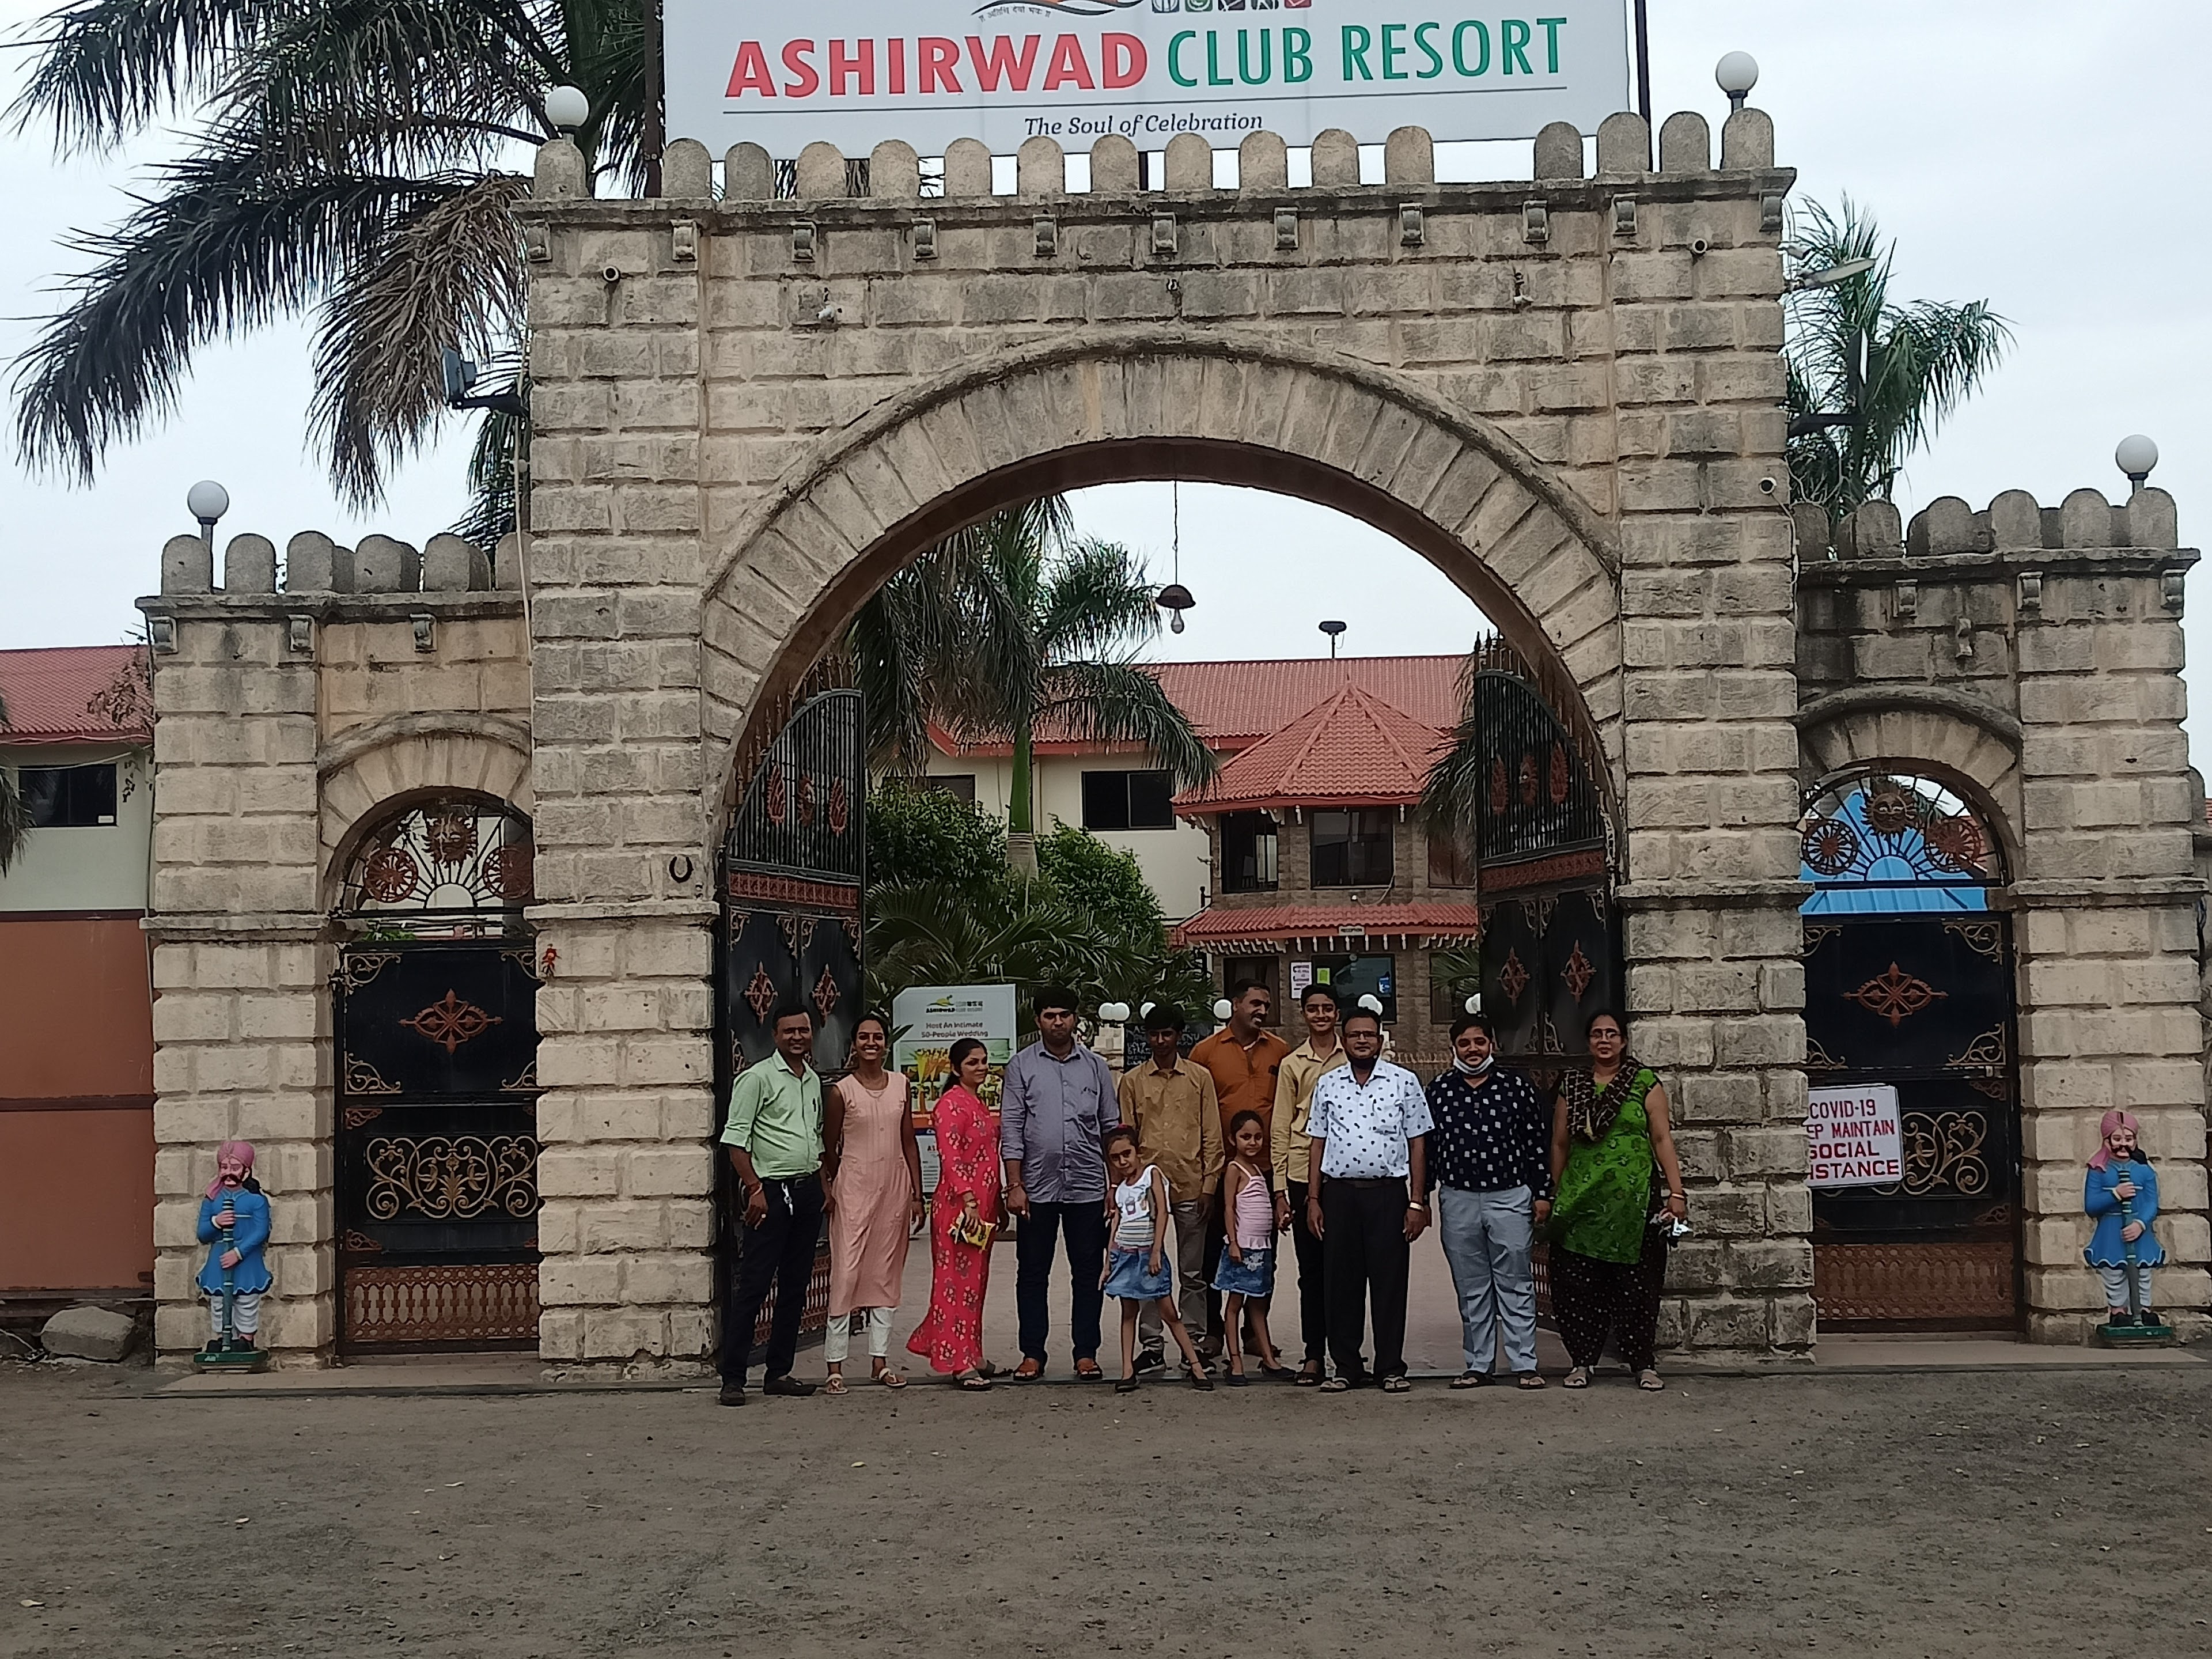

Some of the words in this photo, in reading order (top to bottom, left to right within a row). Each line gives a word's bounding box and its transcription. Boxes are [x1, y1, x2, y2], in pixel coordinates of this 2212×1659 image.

[724, 32, 1148, 98] ASHIRWAD
[1168, 27, 1313, 87] CLUB
[1342, 17, 1568, 81] RESORT
[1025, 117, 1062, 135] The
[1068, 115, 1113, 134] Soul
[1119, 114, 1143, 137] of
[1145, 112, 1263, 132] Celebration
[1809, 1099, 1876, 1119] COVID-19
[1806, 1124, 1824, 1139] EP
[1831, 1119, 1895, 1138] MAINTAIN
[1809, 1141, 1880, 1160] SOCIAL
[1810, 1160, 1899, 1180] ISTANCE
